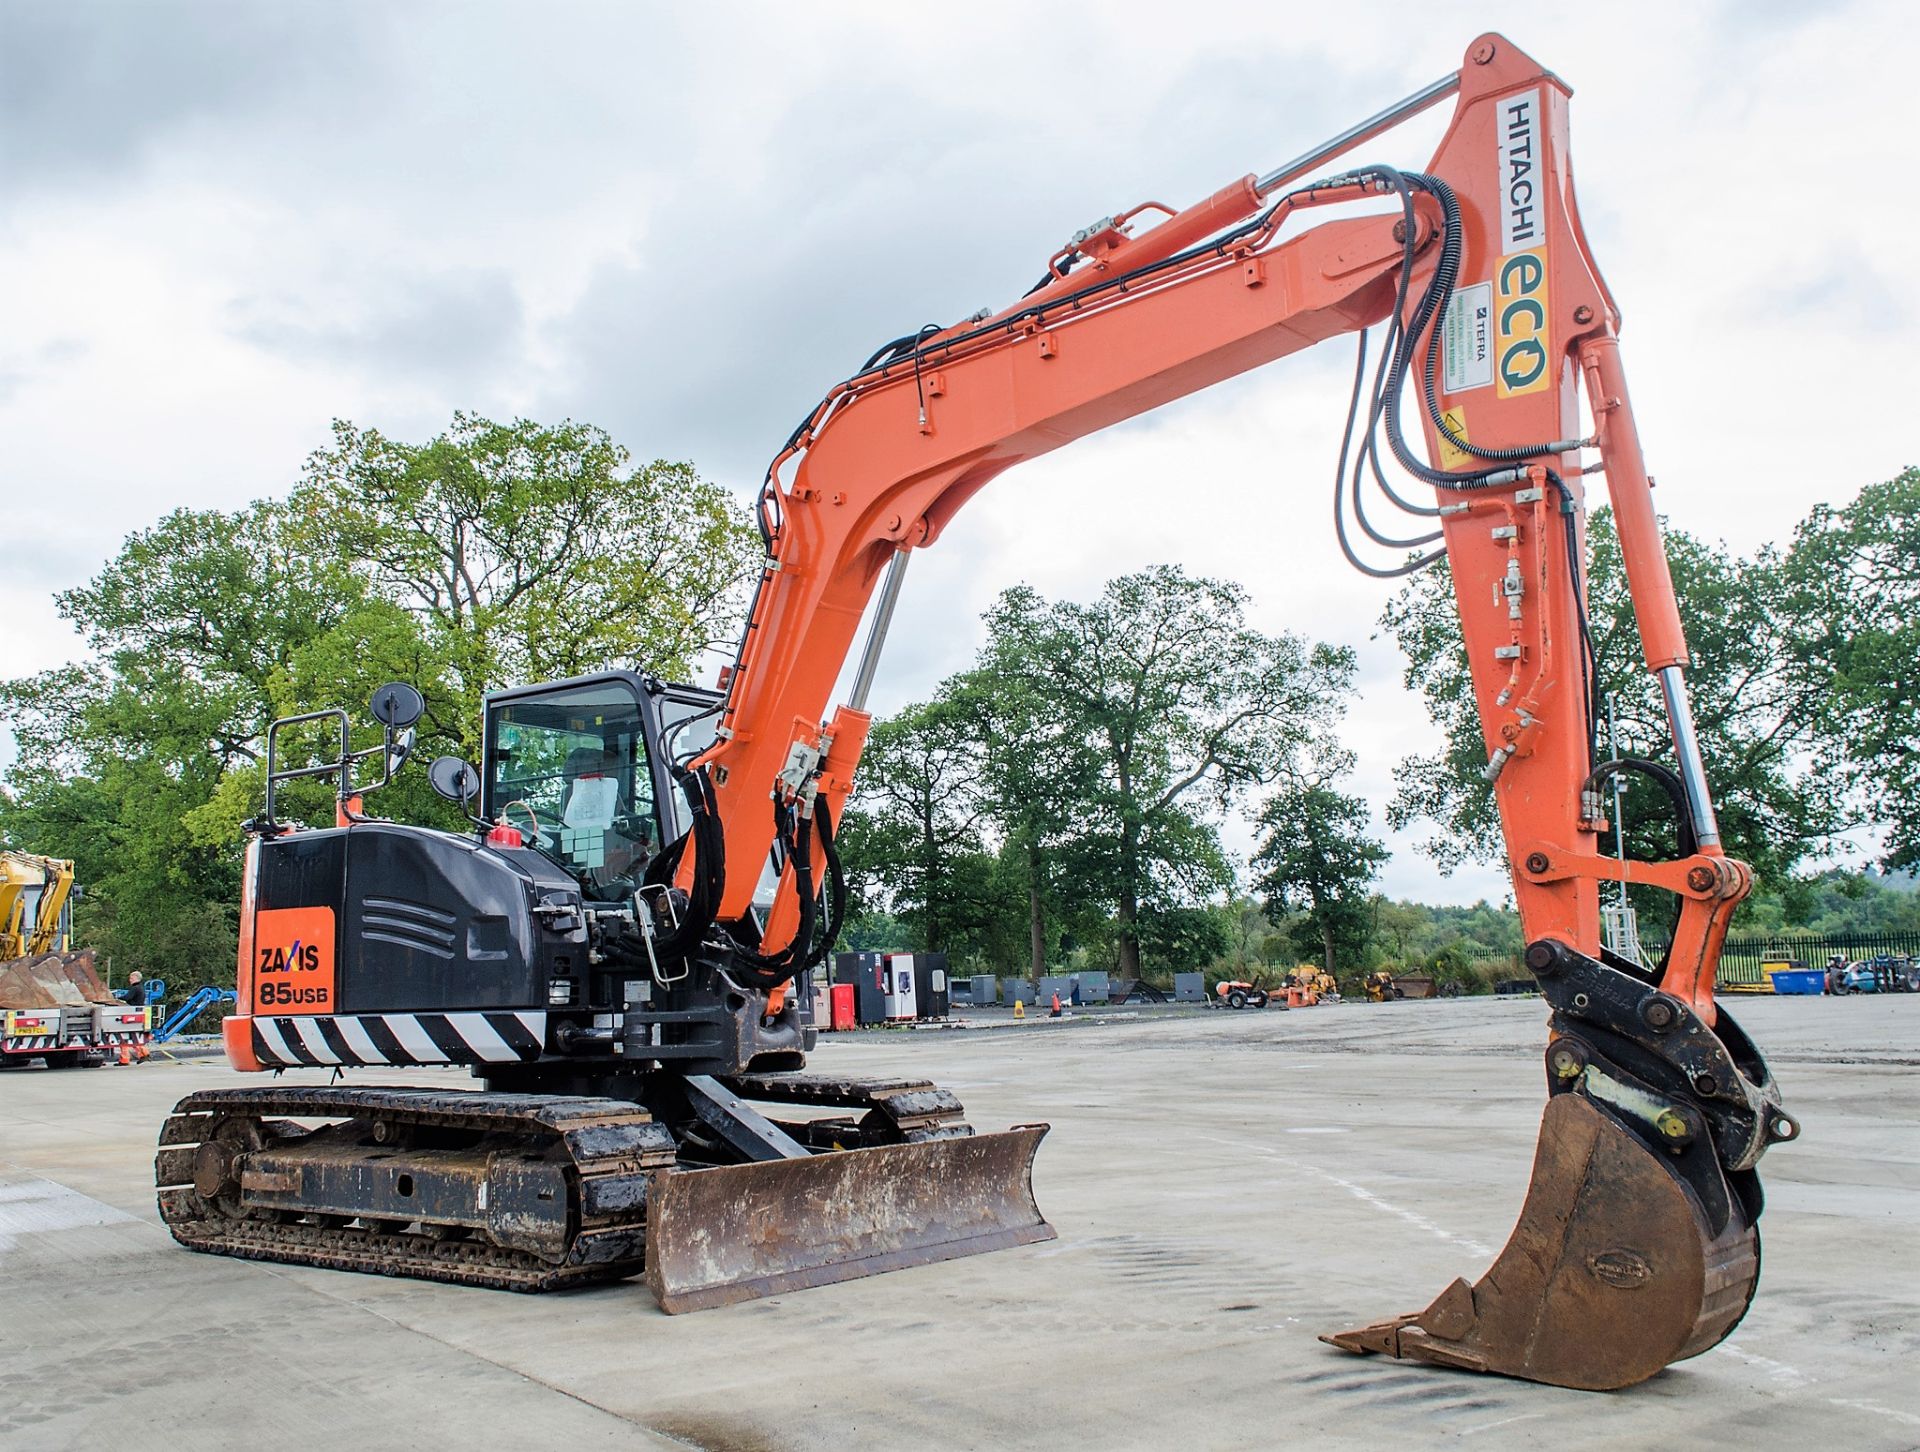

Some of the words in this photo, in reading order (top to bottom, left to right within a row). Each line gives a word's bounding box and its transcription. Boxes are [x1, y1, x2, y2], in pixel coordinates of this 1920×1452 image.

[1508, 102, 1534, 242] HITACHI
[1476, 321, 1485, 361] TEFRA
[260, 939, 319, 973] ZAXIS
